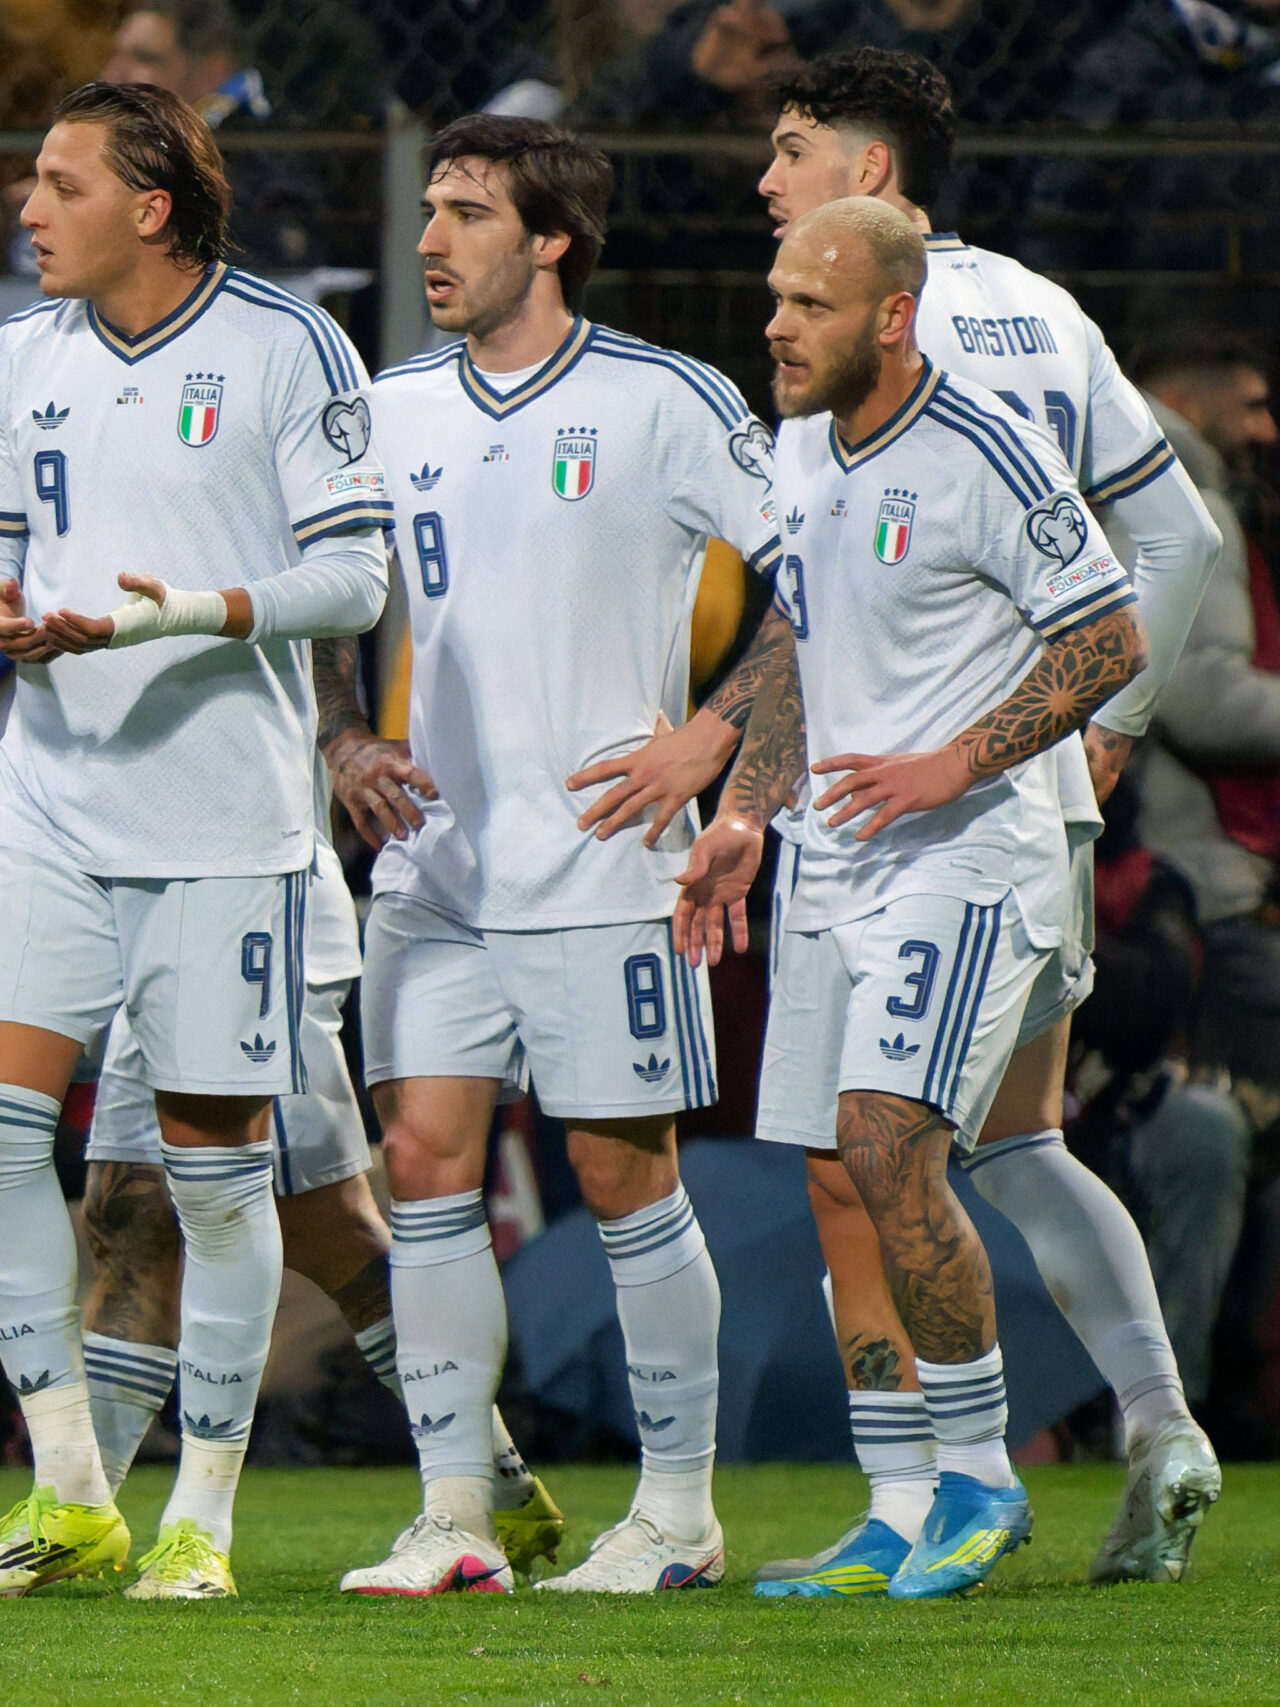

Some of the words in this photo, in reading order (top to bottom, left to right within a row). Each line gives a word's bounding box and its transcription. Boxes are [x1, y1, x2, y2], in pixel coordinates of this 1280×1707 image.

[952, 315, 1058, 356] BASTONI
[185, 388, 217, 401] ITALIA
[558, 442, 593, 455] ITALIA
[33, 449, 70, 538] 9
[882, 503, 911, 519] ITALIA
[413, 510, 449, 600] 8
[785, 554, 809, 643] 3
[240, 931, 273, 1020] 9
[624, 952, 668, 1041] 8
[886, 938, 942, 1022] 3
[182, 1359, 242, 1385] ITALIA
[398, 1360, 459, 1383] ALIA
